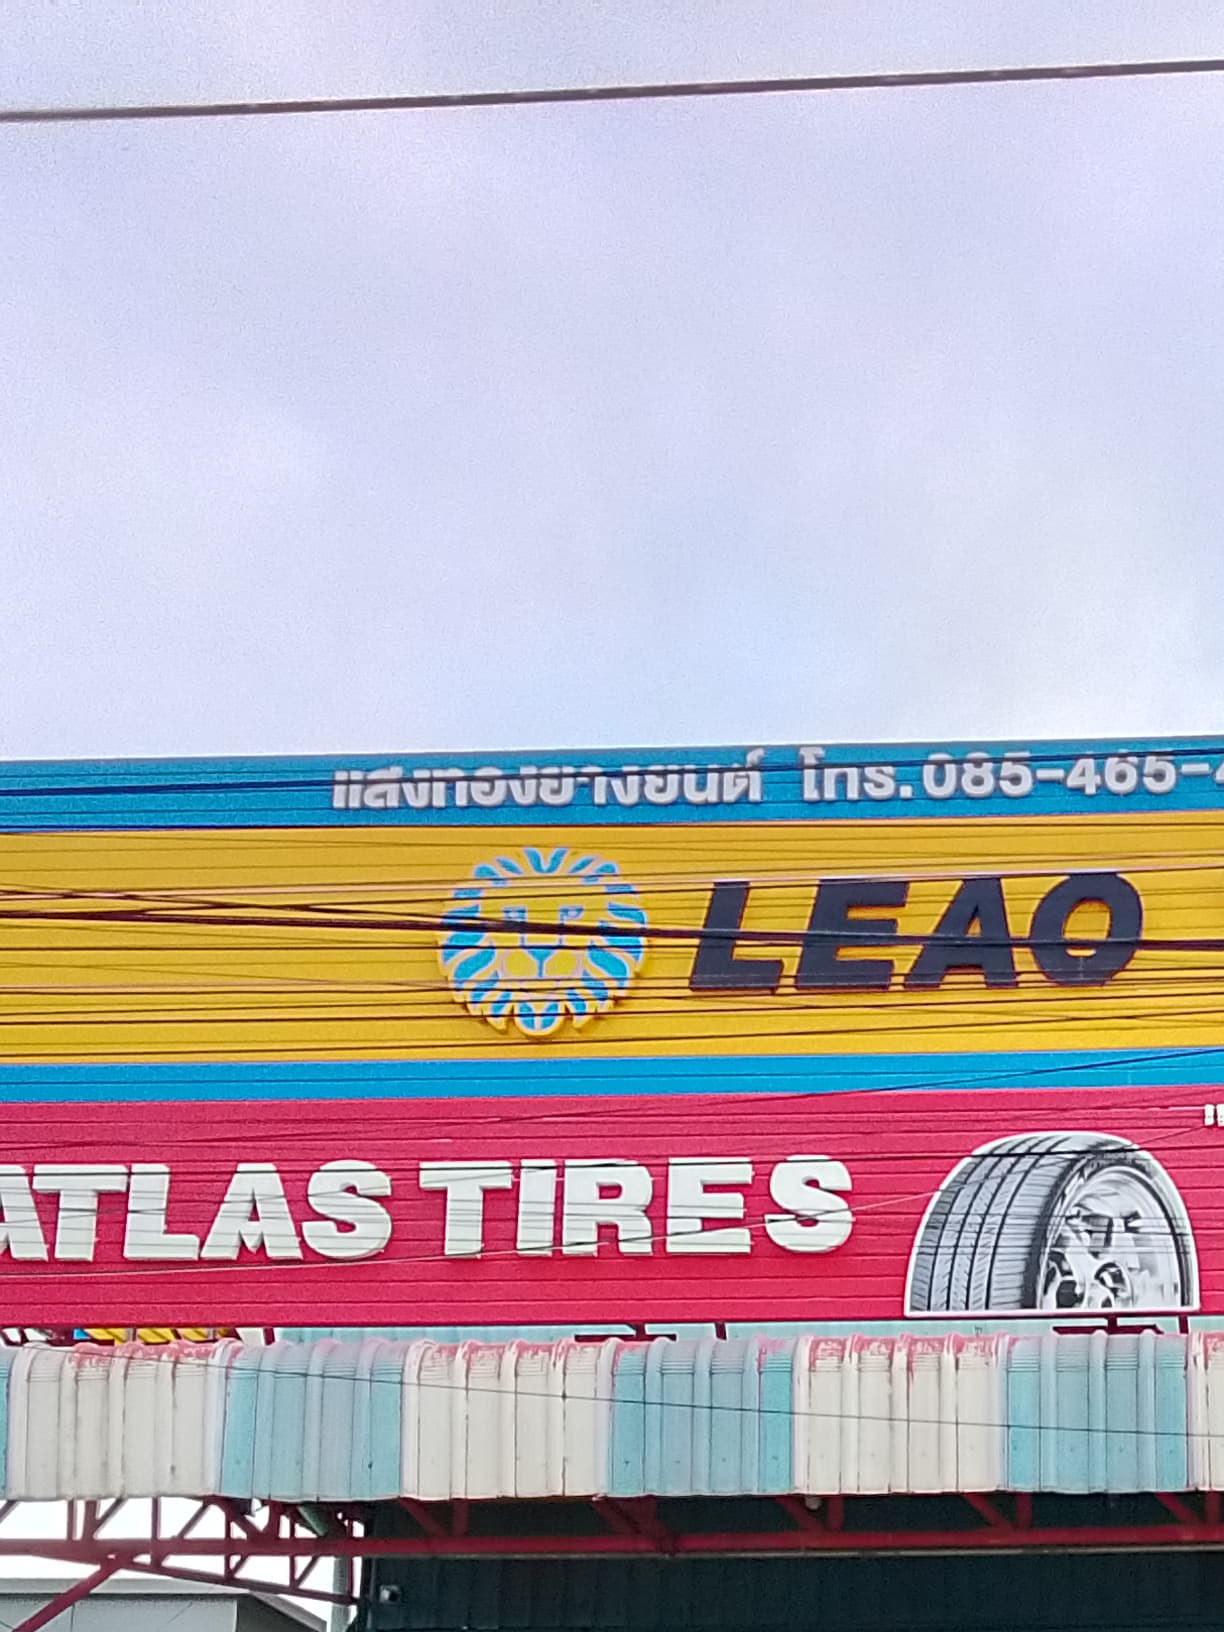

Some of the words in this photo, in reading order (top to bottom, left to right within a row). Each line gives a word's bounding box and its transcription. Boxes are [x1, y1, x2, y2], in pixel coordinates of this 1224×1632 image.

[333, 748, 764, 809] แสงทองยางยนต์
[688, 871, 1143, 995] LEAO
[419, 1154, 854, 1260] TIRES
